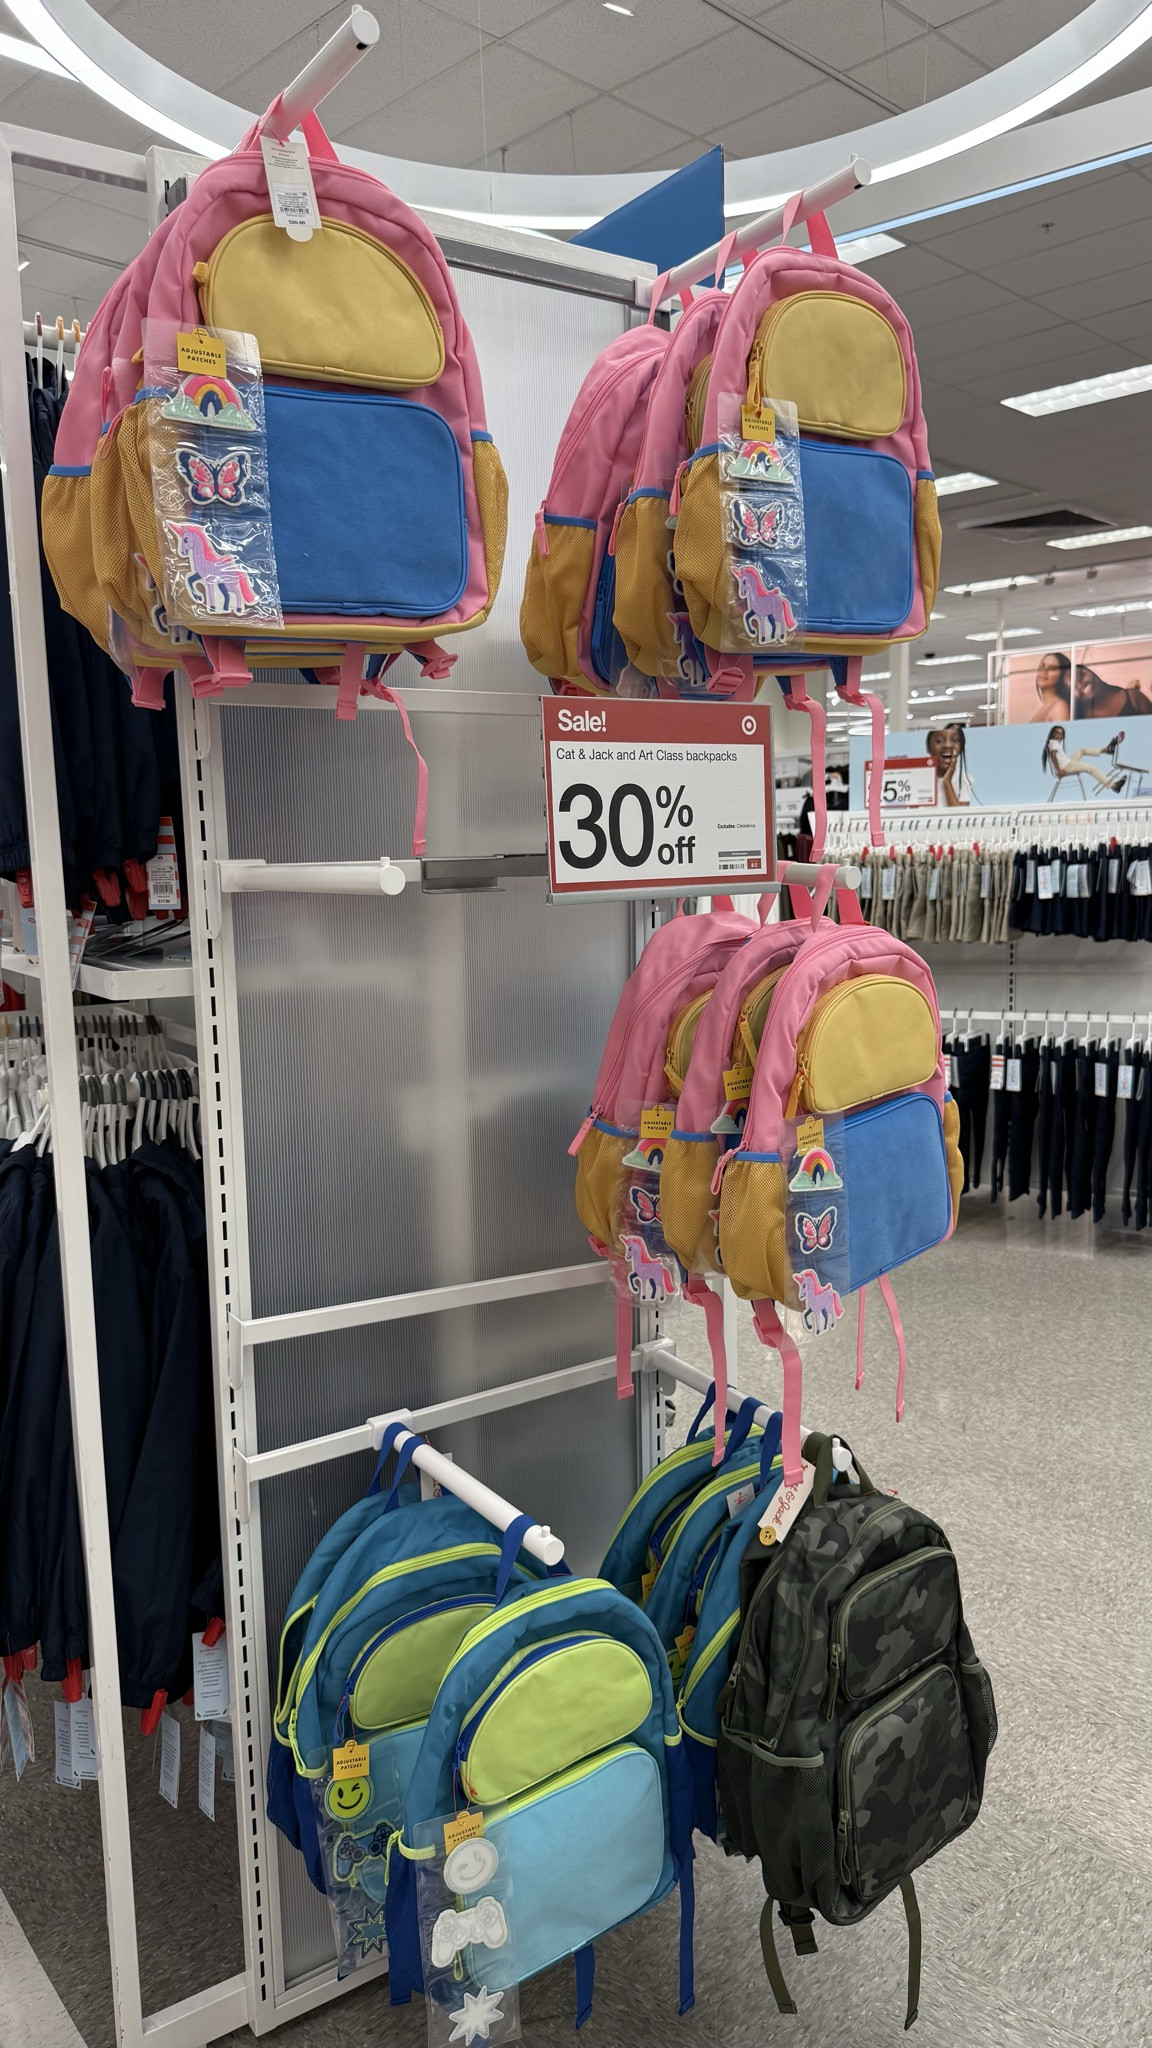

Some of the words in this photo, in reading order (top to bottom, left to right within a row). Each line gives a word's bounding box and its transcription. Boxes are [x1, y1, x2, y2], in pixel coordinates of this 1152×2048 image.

[181, 347, 222, 359] ADJUSTABLE
[187, 355, 216, 365] PATCHES
[557, 708, 607, 733] Sale!
[556, 747, 575, 760] Cat
[578, 748, 587, 760] &
[589, 748, 614, 761] Jack
[616, 749, 636, 761] and
[638, 749, 654, 761] Art
[656, 749, 684, 762] Class
[686, 750, 738, 763] backpacks
[869, 780, 911, 803] 5%
[897, 793, 911, 802] off
[558, 783, 694, 870] 30%
[657, 836, 696, 865] off
[772, 1496, 791, 1525] Jack
[336, 1756, 367, 1765] ADJUSTABLE
[448, 1824, 480, 1839] ADJUSTABLE
[453, 1831, 476, 1843] PATCHES
